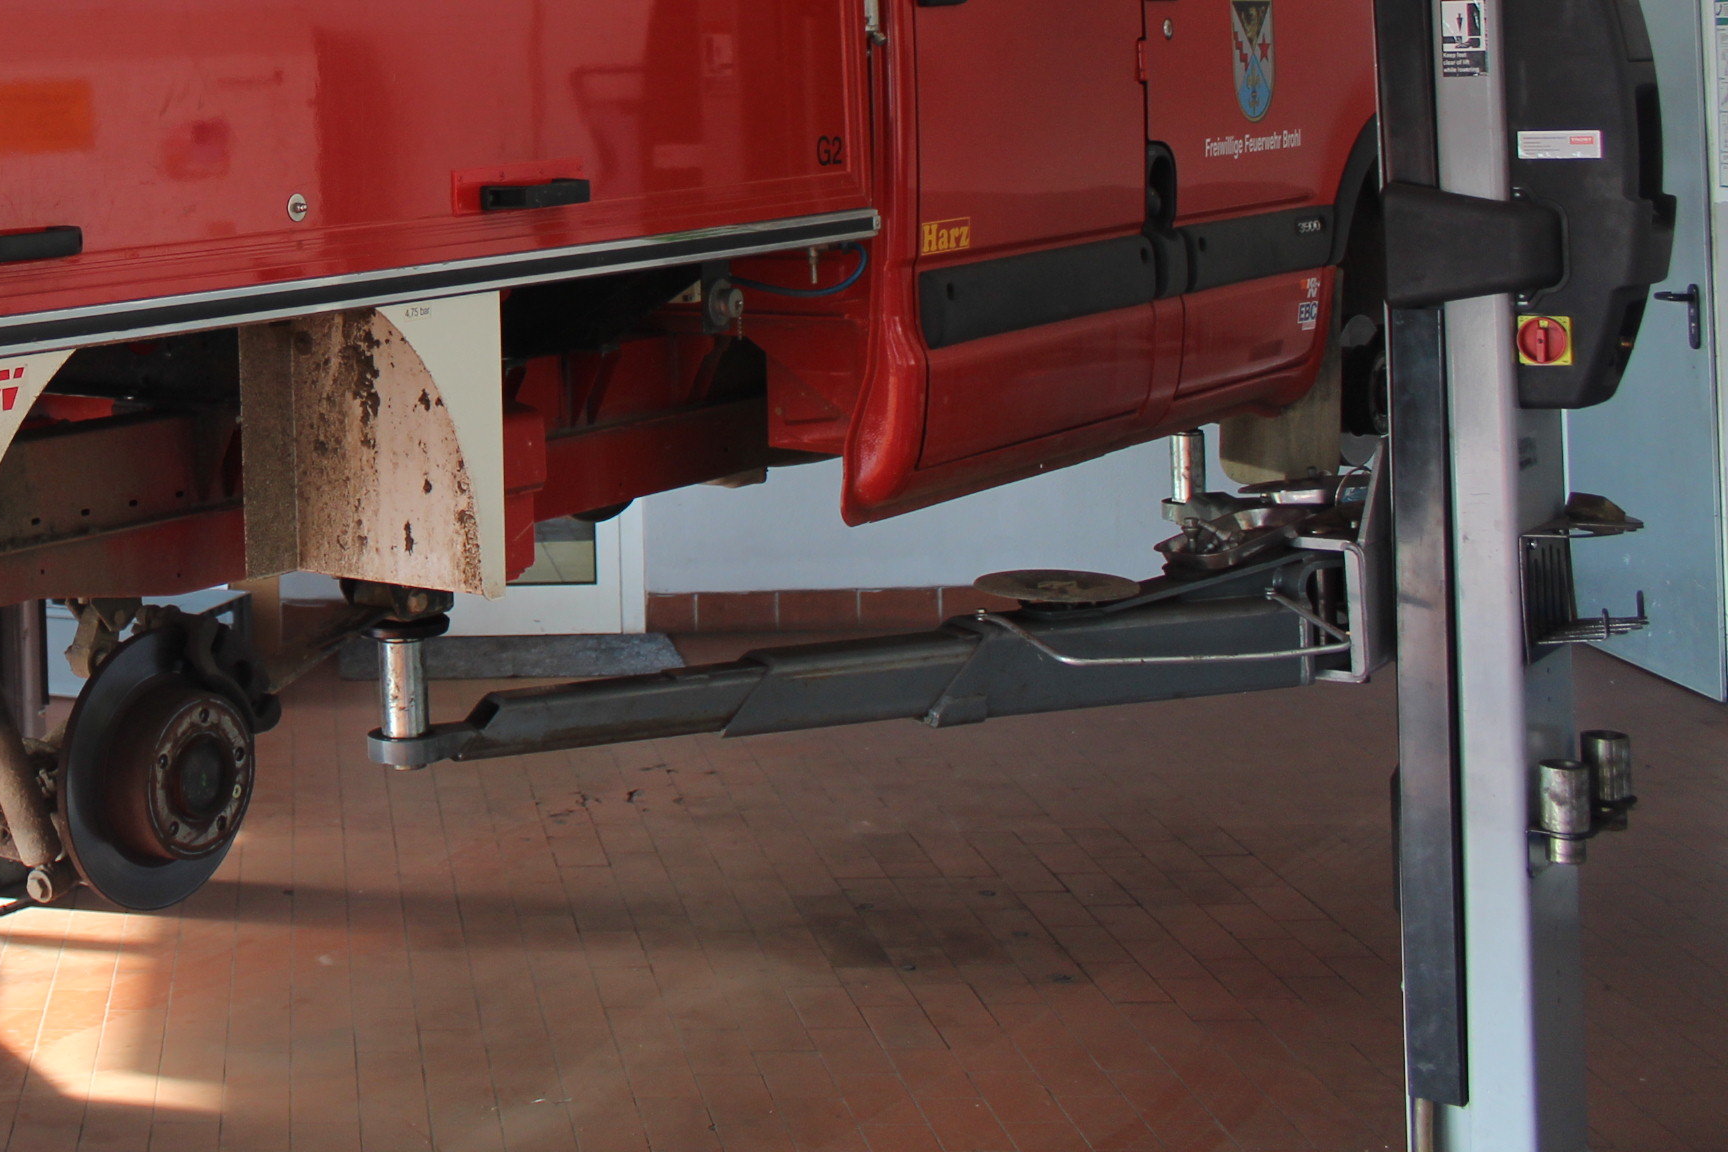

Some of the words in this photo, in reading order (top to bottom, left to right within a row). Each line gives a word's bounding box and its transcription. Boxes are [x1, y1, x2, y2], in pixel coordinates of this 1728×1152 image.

[817, 135, 842, 166] G2
[1204, 136, 1244, 159] Freiwillige
[1244, 132, 1282, 154] Feuerwehr
[1282, 128, 1302, 148] Brohl
[923, 223, 970, 253] Harz
[1299, 302, 1318, 321] EBC
